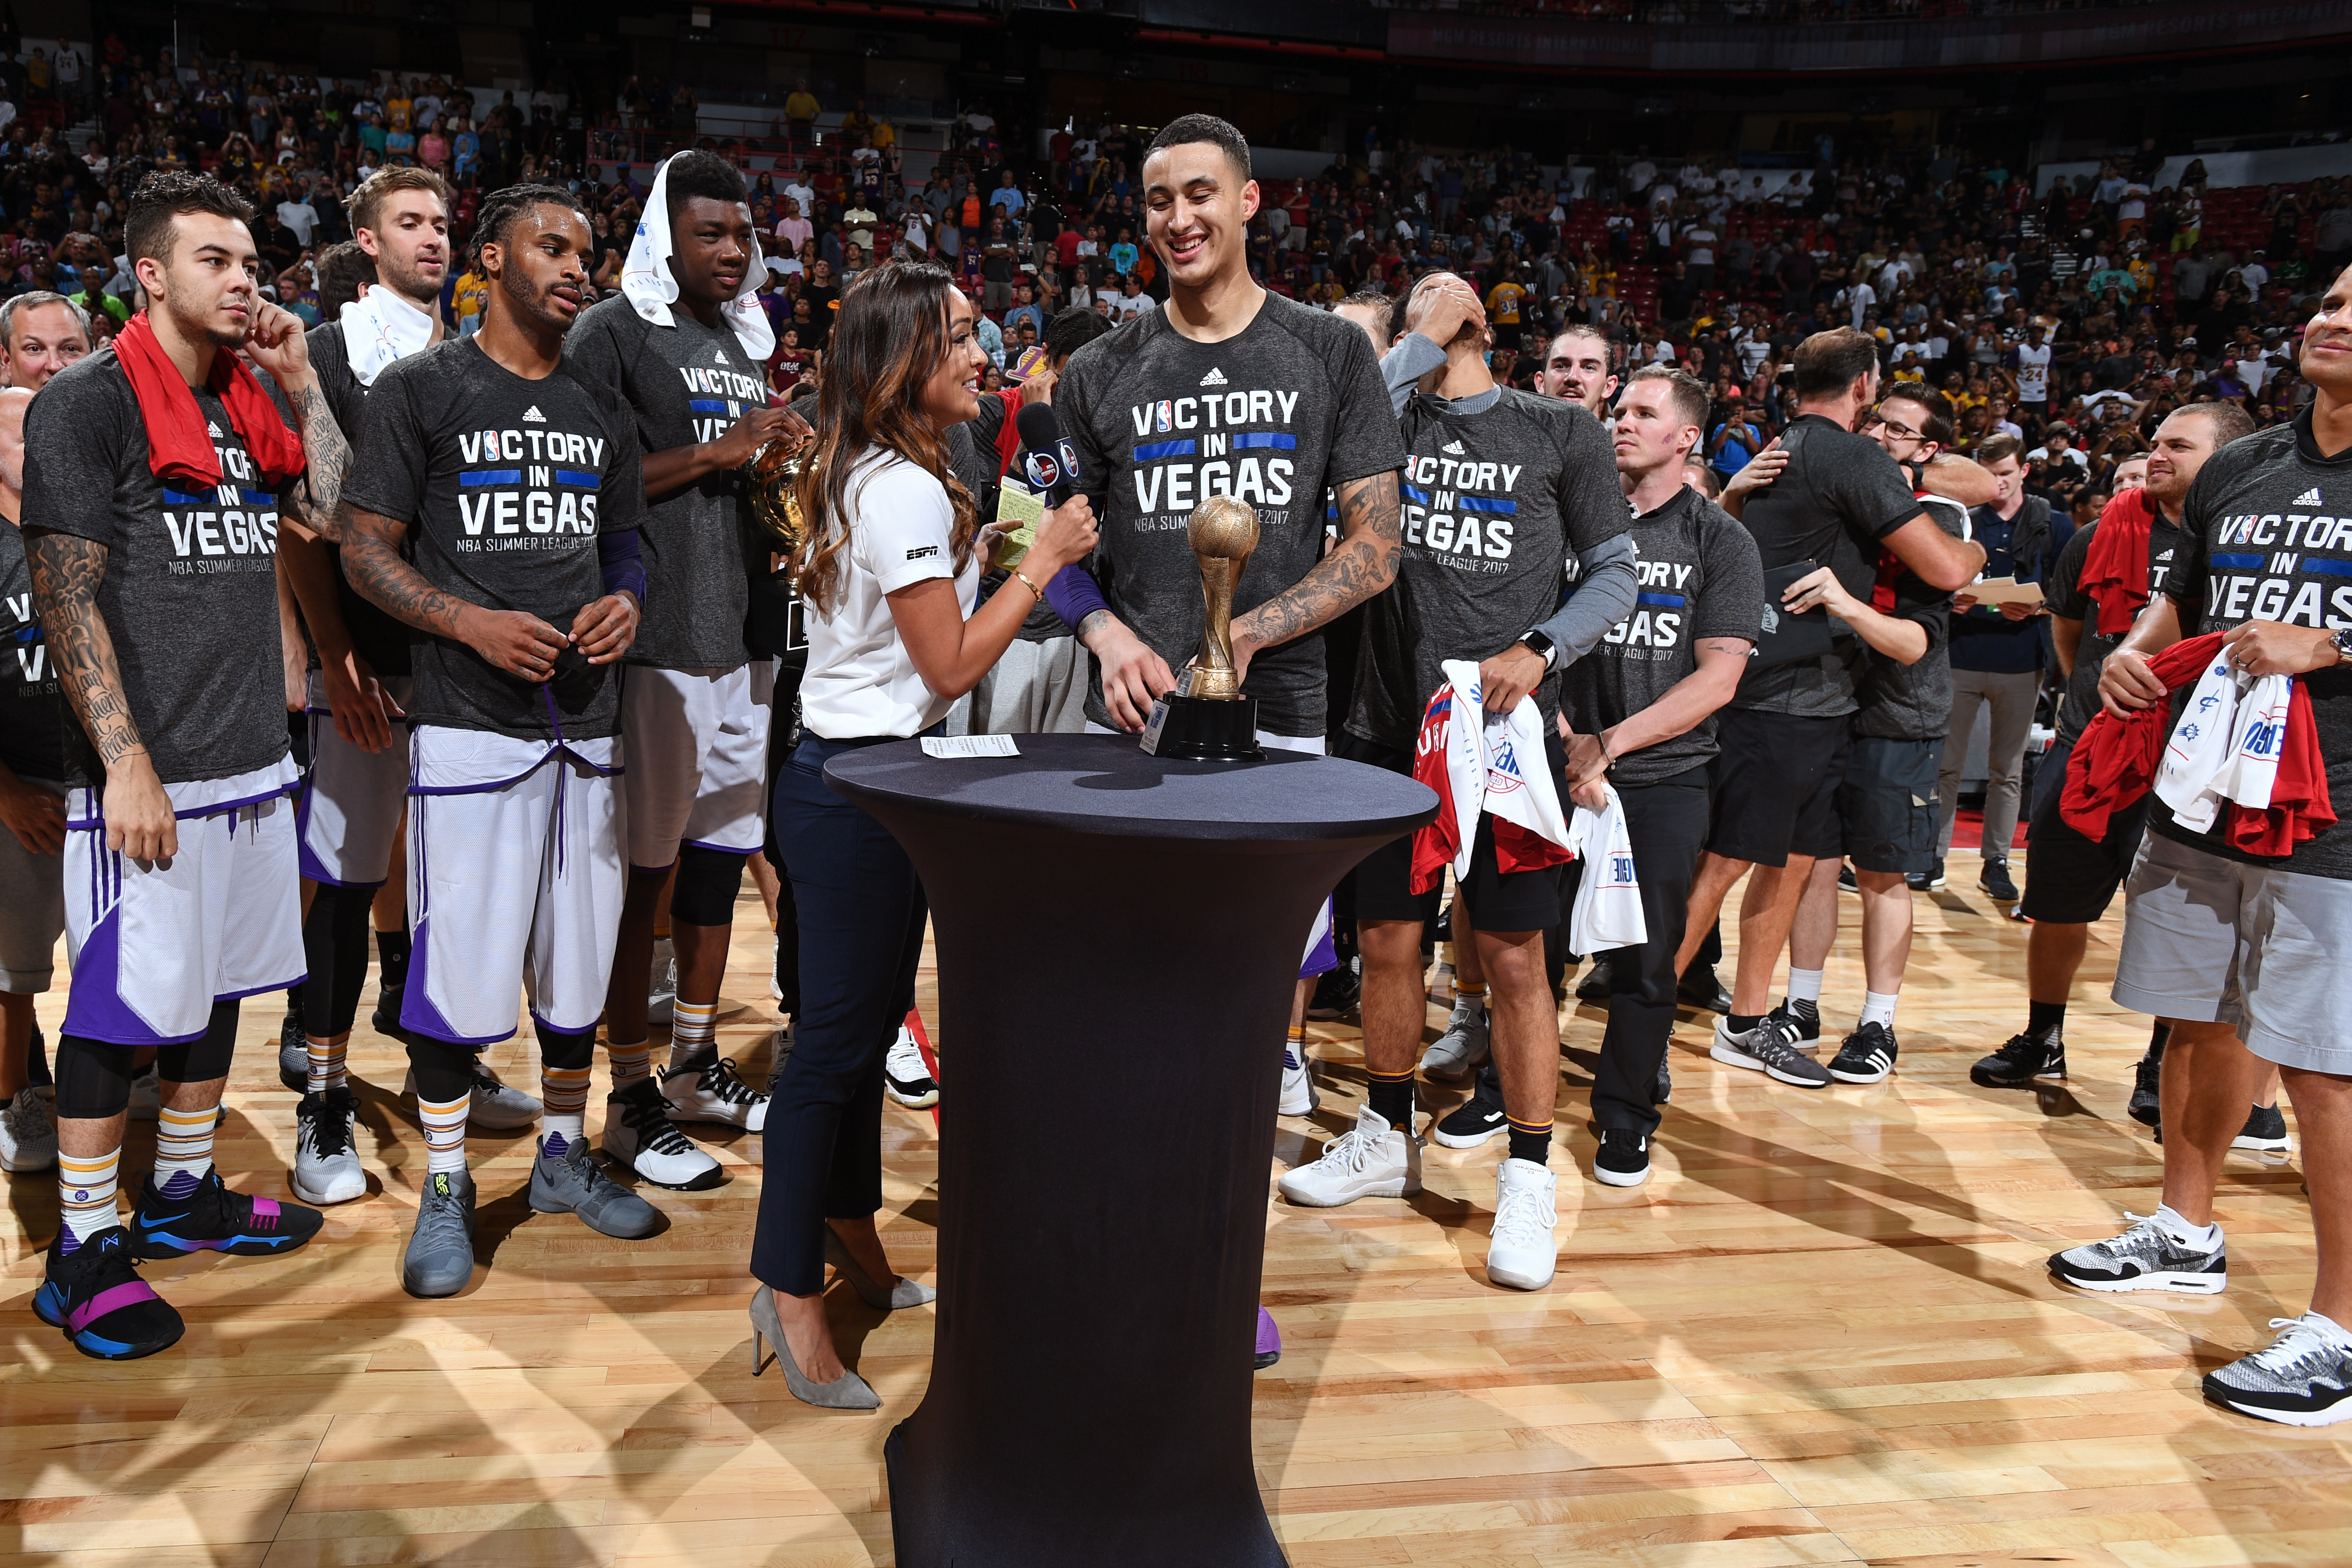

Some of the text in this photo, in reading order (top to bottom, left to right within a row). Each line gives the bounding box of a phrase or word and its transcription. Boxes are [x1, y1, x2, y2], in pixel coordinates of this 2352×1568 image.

[865, 174, 878, 185] 33
[911, 221, 917, 229] 6
[1500, 297, 1518, 315] 32
[1200, 378, 1228, 386] adidas
[2025, 370, 2043, 382] 24
[727, 400, 741, 419] IN
[1203, 433, 1226, 458] IN
[1442, 445, 1466, 455] adidas
[528, 465, 549, 487] IN
[1041, 468, 1056, 477] ESPN
[1133, 457, 1294, 514] VEGAS
[217, 485, 241, 507] IN
[1434, 490, 1455, 511] IN
[458, 491, 597, 535] VEGAS
[1264, 509, 1289, 525] 2017
[1134, 515, 1192, 533] NBA SUM
[163, 511, 278, 556] VEGAS
[456, 538, 481, 552] NBA
[486, 536, 538, 552] SUMMER
[542, 535, 580, 550] LEAGUE
[906, 545, 938, 561] ESPN
[169, 561, 194, 576] NBA
[198, 559, 242, 575] SUMMER
[1437, 552, 1480, 573] LEAGUE
[1483, 561, 1509, 575] 2017
[2268, 552, 2298, 575] IN
[2208, 575, 2352, 630] VEGAS
[1614, 646, 1650, 660] LEAGUE
[1652, 649, 1673, 661] 2017
[19, 685, 42, 697] NBA
